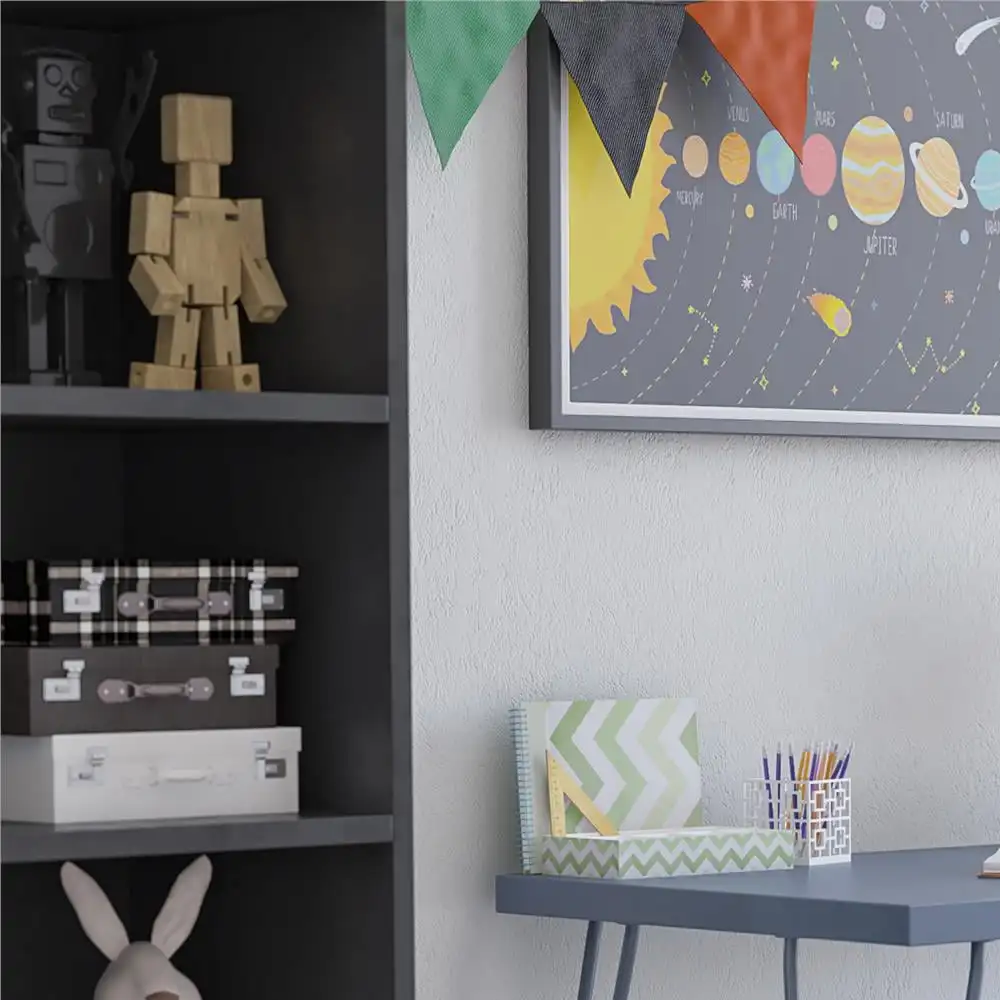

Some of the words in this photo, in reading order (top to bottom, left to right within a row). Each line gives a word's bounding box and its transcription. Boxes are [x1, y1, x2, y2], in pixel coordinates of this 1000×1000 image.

[727, 105, 749, 122] VENUS
[814, 110, 836, 127] MARS
[936, 111, 964, 129] SATURN
[772, 202, 798, 220] EARTH
[863, 235, 898, 256] JUPITER
